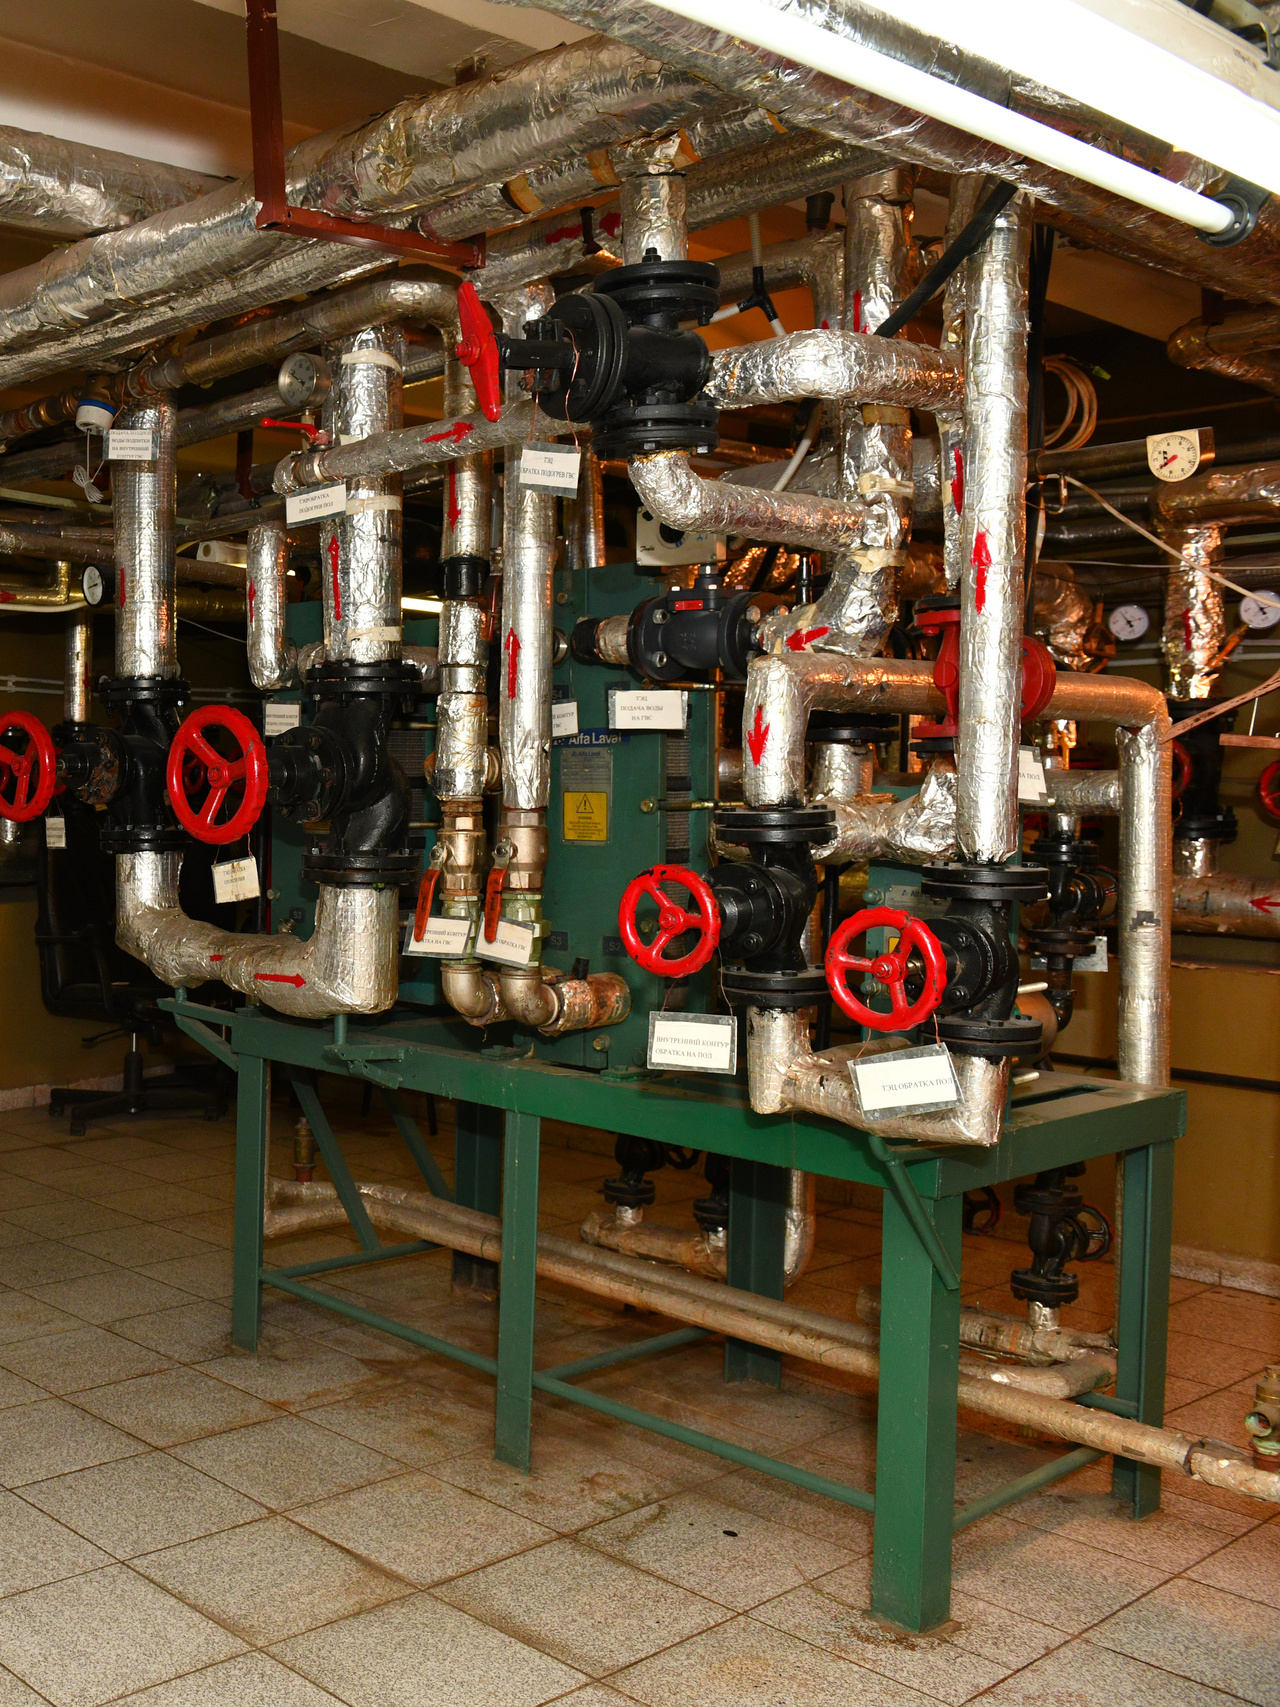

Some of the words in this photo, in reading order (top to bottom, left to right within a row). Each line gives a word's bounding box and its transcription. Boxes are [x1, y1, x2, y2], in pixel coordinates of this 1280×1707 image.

[568, 732, 591, 745] Alfa
[551, 935, 562, 946] S3
[609, 941, 621, 951] S2
[656, 1036, 701, 1046] ВНУТРЕННИЙ
[701, 1039, 730, 1048] КОНТУР
[655, 1048, 685, 1057] ОБРАТКА
[881, 1083, 898, 1092] ТЭЦ
[898, 1079, 935, 1090] ОБРАТКА
[935, 1077, 953, 1086] ПОЛ
